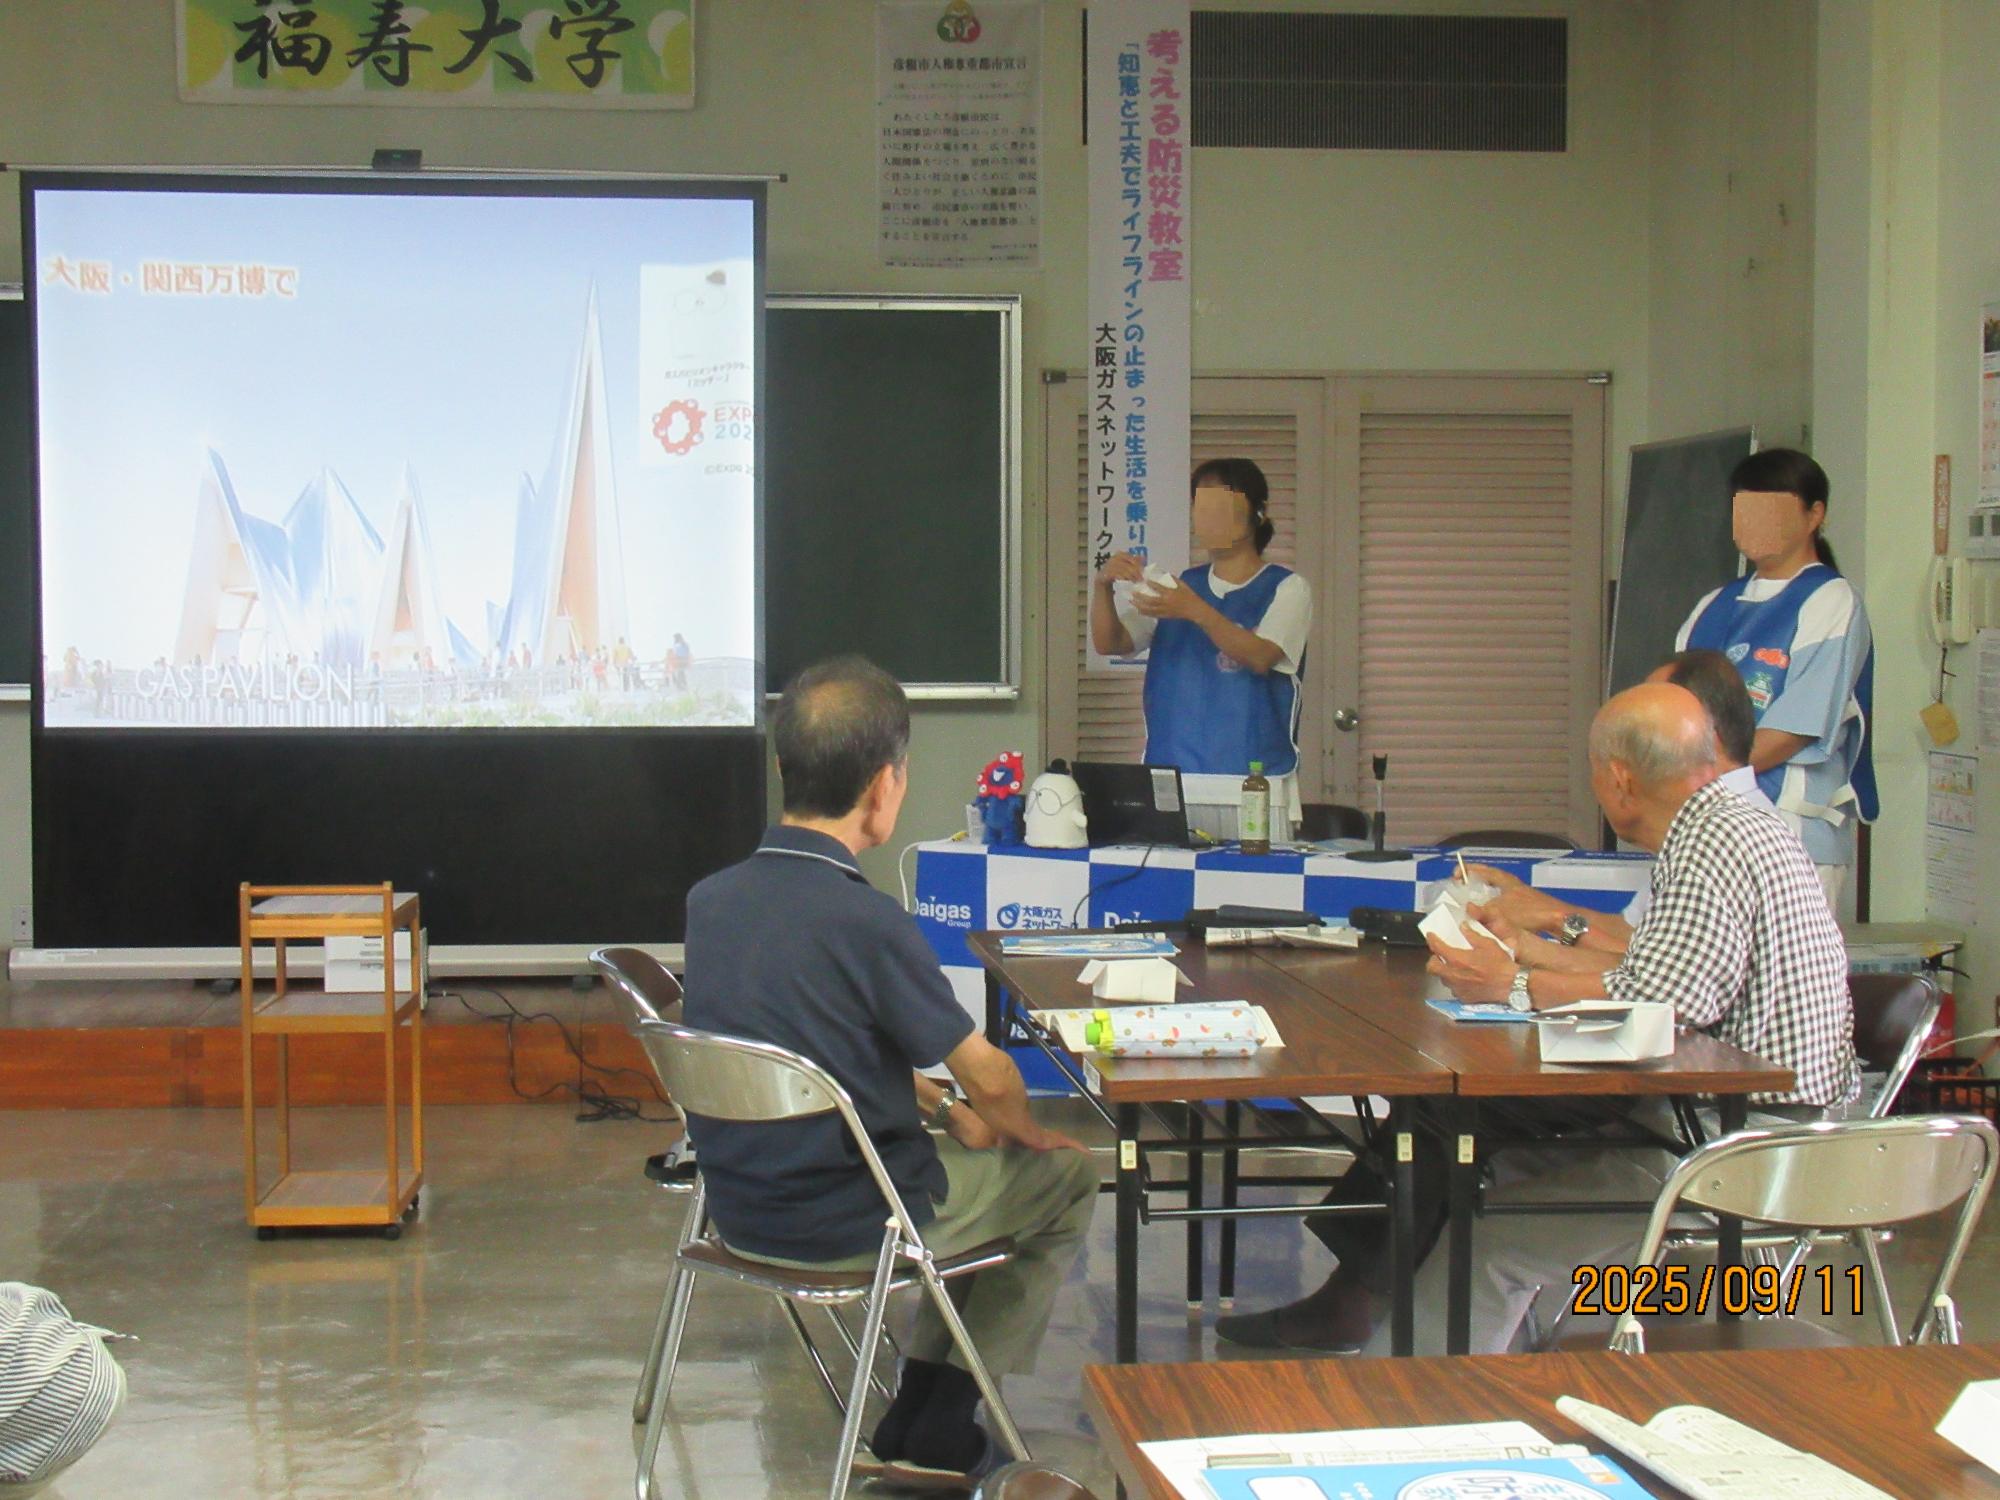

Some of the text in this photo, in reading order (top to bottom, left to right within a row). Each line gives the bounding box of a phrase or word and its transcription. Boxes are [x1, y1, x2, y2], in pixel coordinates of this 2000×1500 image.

[234, 0, 635, 88] 福寿大学
[1148, 29, 1183, 281] 考える防災教室
[43, 256, 298, 297] 大阪・関西万博で
[136, 663, 353, 701] GAS PAVILION
[1022, 906, 1063, 920] 大阪ガス
